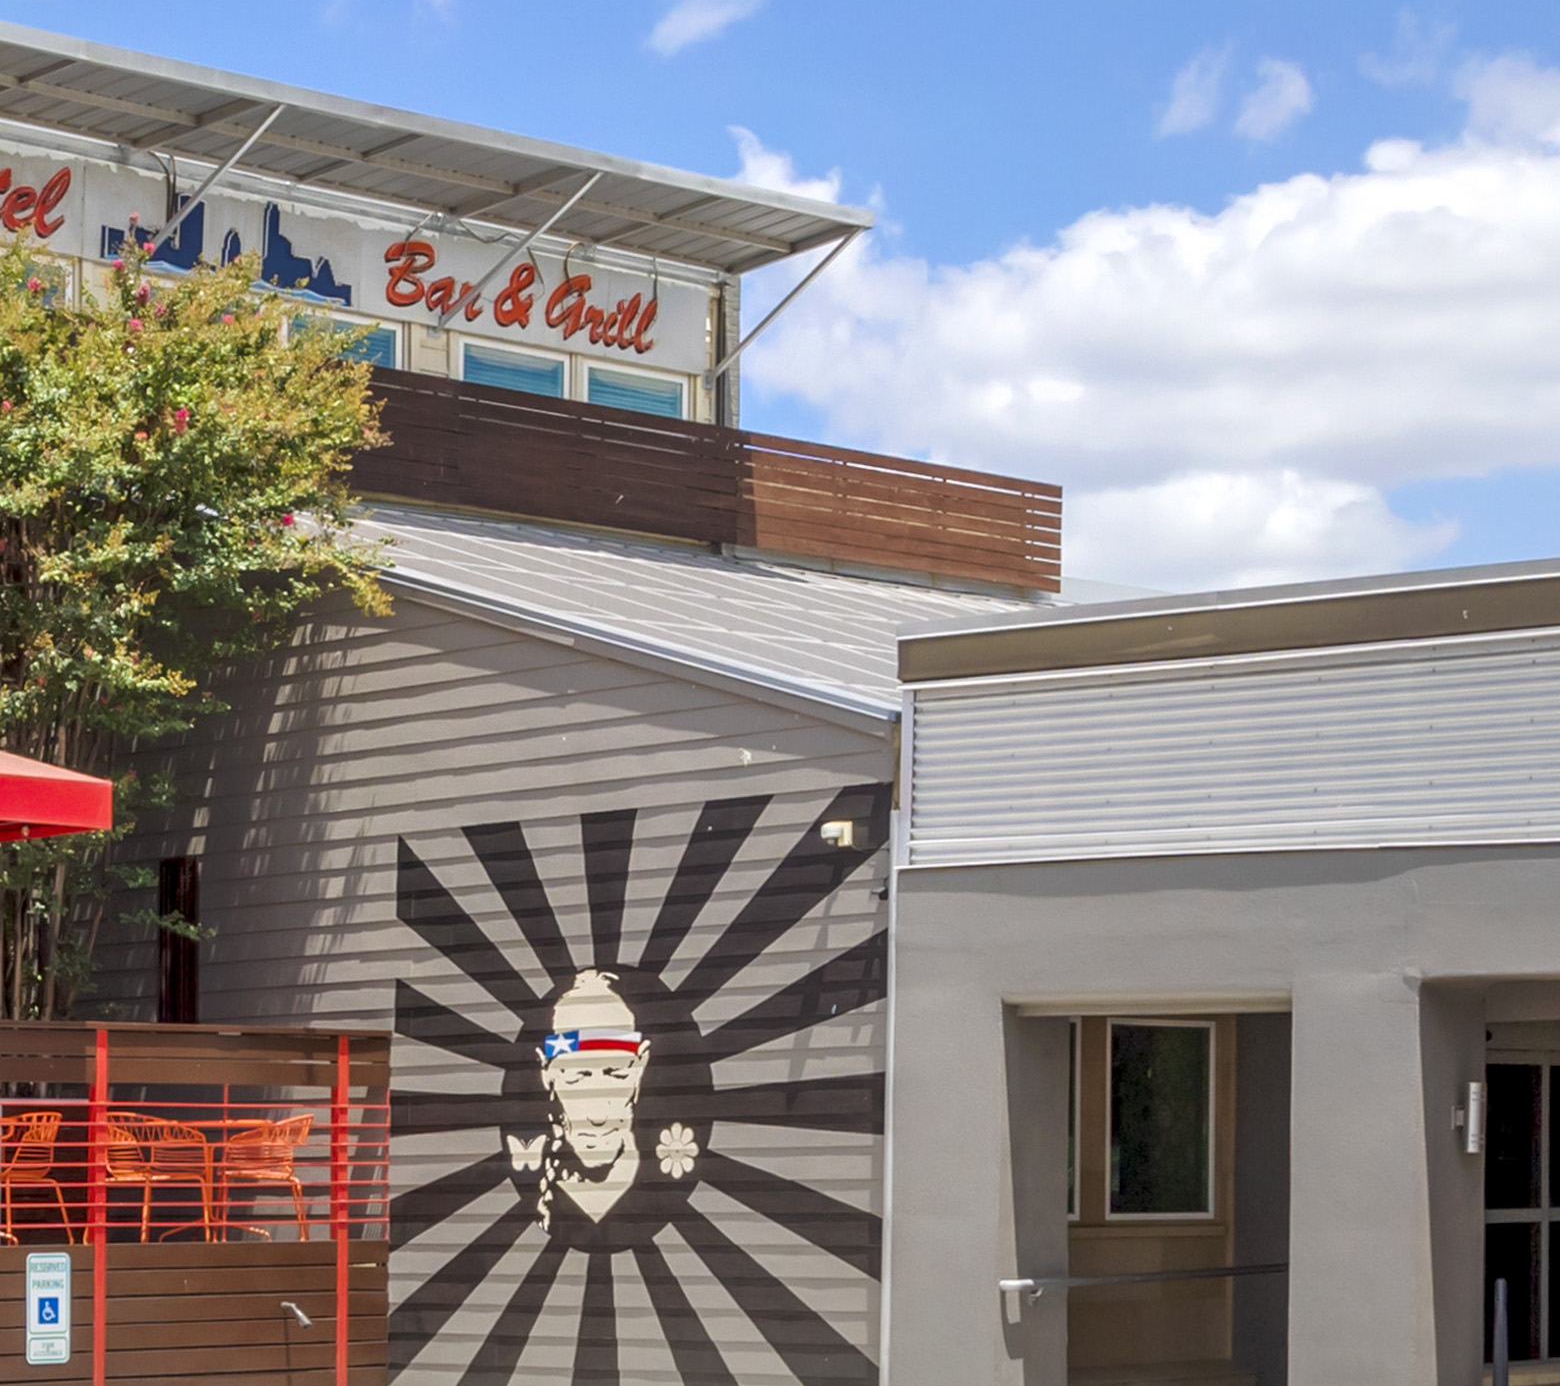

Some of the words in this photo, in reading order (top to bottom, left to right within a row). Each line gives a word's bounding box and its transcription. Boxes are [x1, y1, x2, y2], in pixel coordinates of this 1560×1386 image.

[384, 240, 484, 322] Bar
[493, 262, 536, 329] &
[545, 274, 659, 354] Grill
